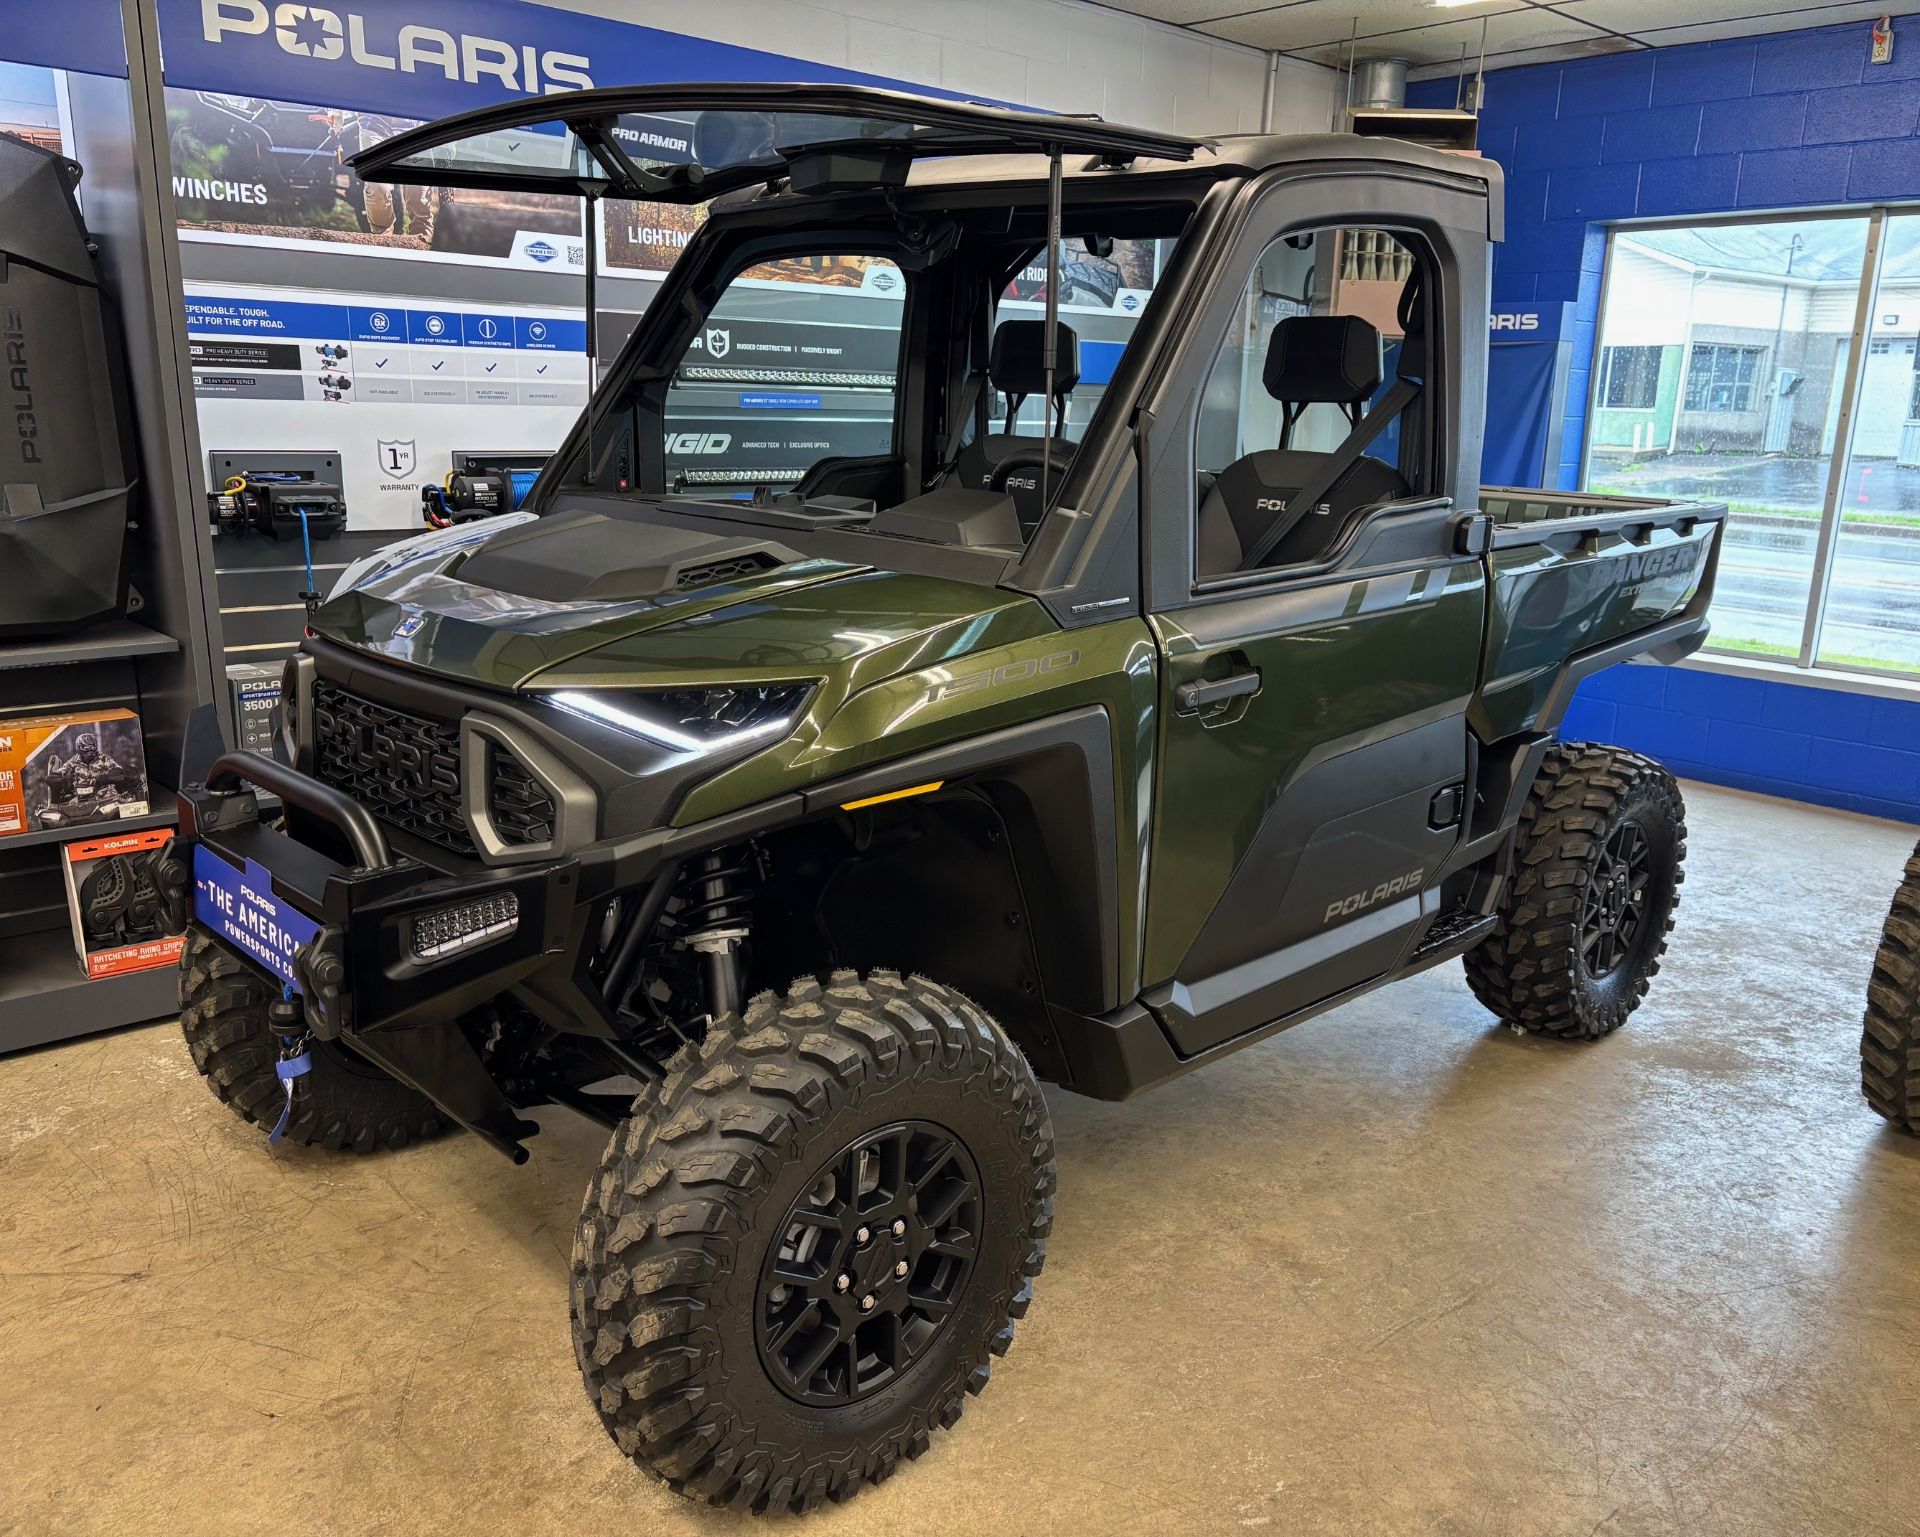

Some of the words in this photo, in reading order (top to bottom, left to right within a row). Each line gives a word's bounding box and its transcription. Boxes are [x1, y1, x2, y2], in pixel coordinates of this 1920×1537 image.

[202, 0, 594, 95] POLARIS
[611, 127, 639, 142] PRO
[639, 132, 688, 152] ARMOR
[185, 305, 237, 315] EPENDABLE.
[239, 308, 269, 317] TOUGH.
[1489, 313, 1539, 330] ARIS
[186, 316, 203, 325] UILT
[206, 316, 222, 325] FOR
[224, 318, 240, 326] THE
[243, 319, 258, 328] OFF
[260, 319, 285, 329] ROAD.
[756, 344, 792, 352] CONSTRUCTION
[3, 305, 43, 464] POLARIS
[388, 448, 402, 470] 1
[982, 474, 1036, 490] PARIS
[242, 680, 282, 692] POLA
[924, 649, 1082, 703] 1500
[244, 699, 273, 712] 3500
[104, 838, 139, 850] KOLPIN
[241, 884, 276, 917] POLARIS
[1323, 867, 1424, 924] POLARIS
[208, 880, 233, 916] THE
[239, 902, 300, 957] AMERIC
[93, 948, 138, 964] RATCHETING
[140, 944, 160, 955] RHINO
[224, 919, 280, 969] POWERSPORTS
[283, 961, 296, 981] CO.
